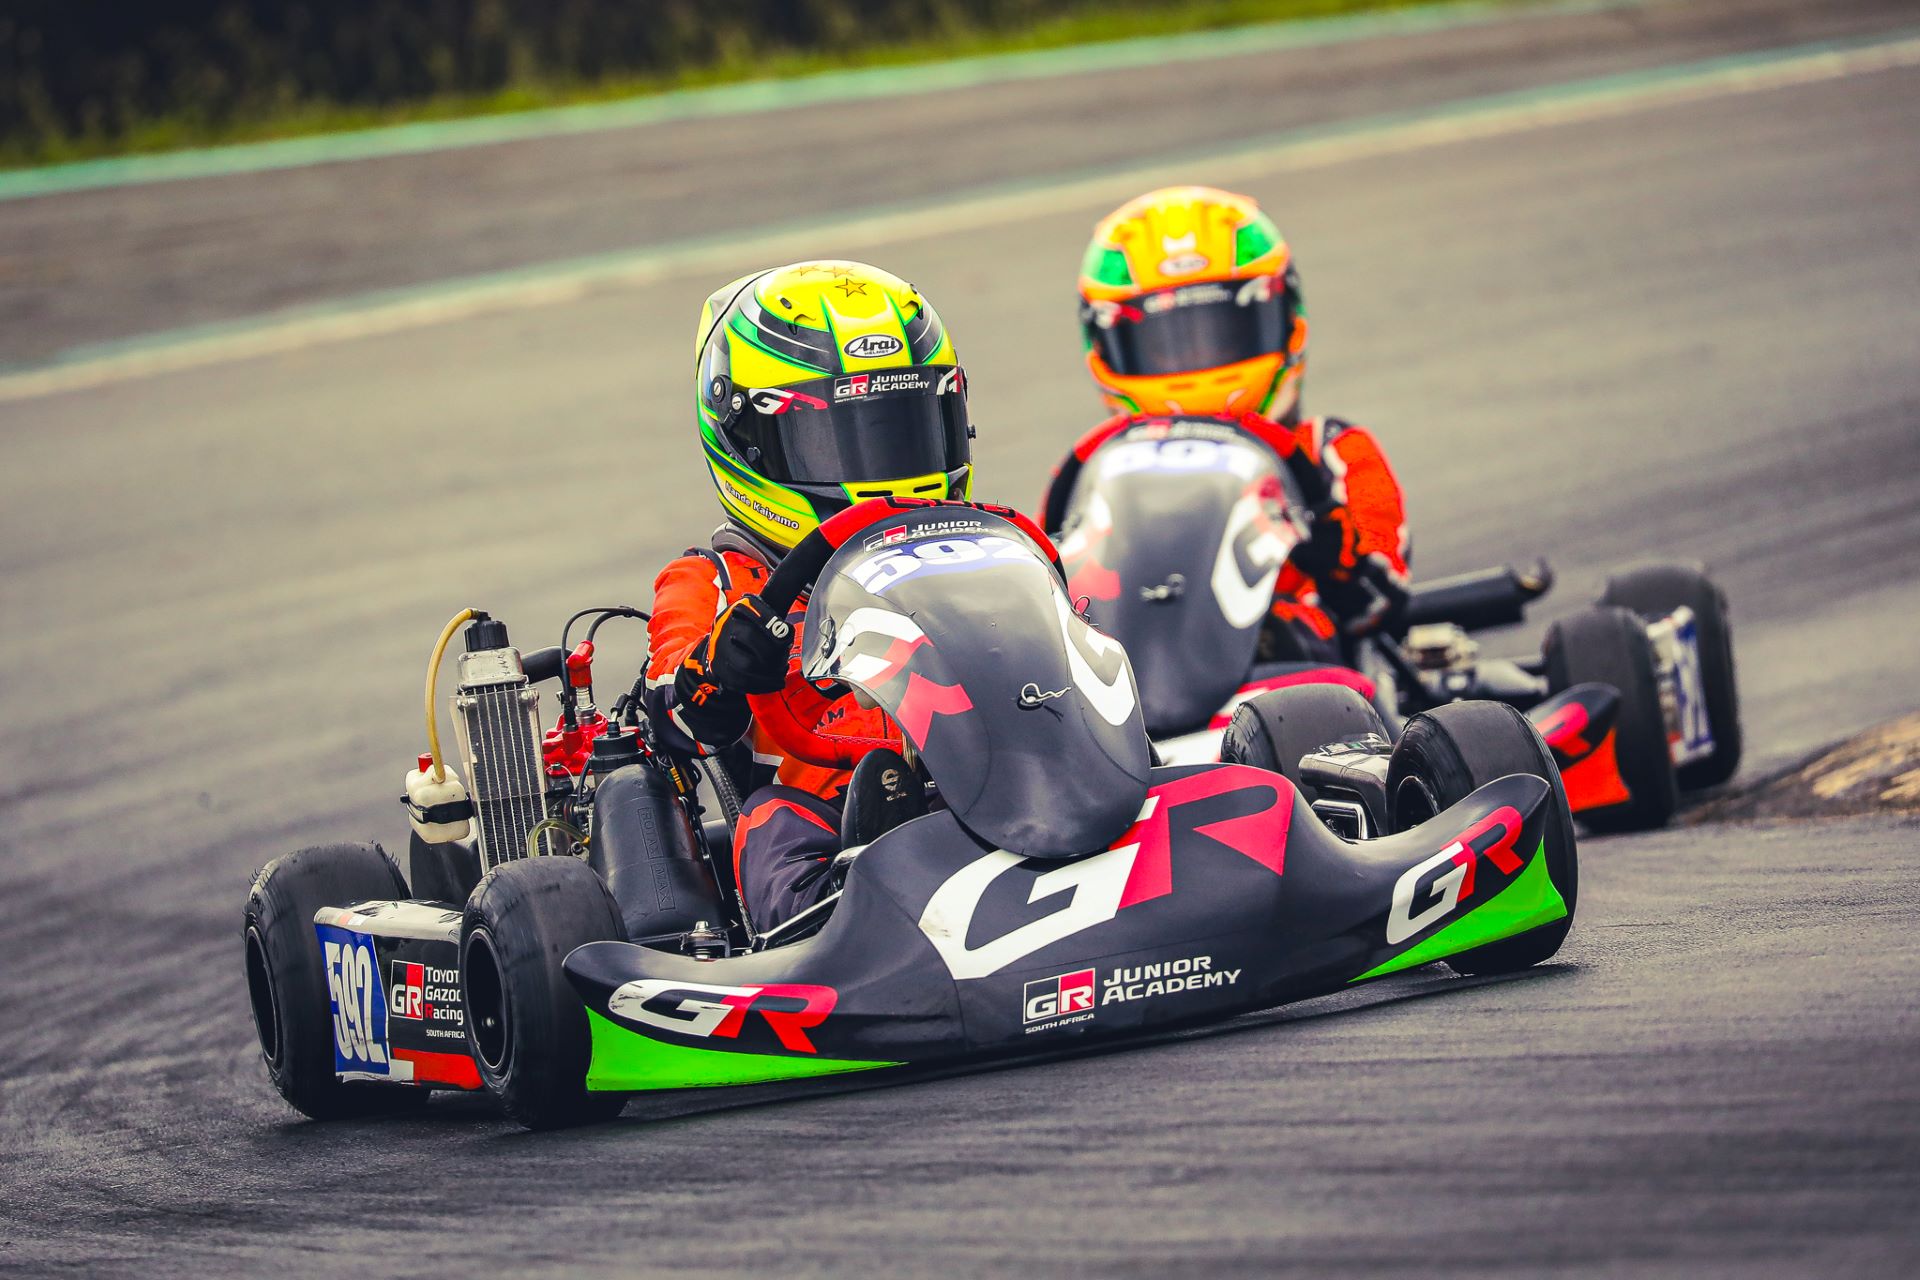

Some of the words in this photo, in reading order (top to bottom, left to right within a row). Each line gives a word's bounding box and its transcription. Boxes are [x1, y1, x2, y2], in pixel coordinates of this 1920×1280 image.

[850, 336, 897, 354] Arai
[835, 382, 868, 397] GR
[870, 381, 930, 393] ACADEMY
[872, 373, 919, 384] JUNIOR
[725, 480, 752, 507] Nande
[752, 500, 800, 530] Kaiyamo
[911, 527, 1000, 539] ACADEMY
[912, 520, 982, 533] JUNIOR
[851, 536, 1046, 594] 592
[920, 766, 1292, 980] GR
[1387, 806, 1523, 944] GR
[425, 966, 459, 983] TOYOT
[1103, 956, 1212, 987] JUNIOR
[391, 983, 422, 1017] GR
[1101, 969, 1242, 1006] ACADEMY
[325, 942, 387, 1063] 592
[425, 1004, 463, 1025] Racing
[1026, 985, 1093, 1019] GR
[608, 979, 838, 1053] GR
[1025, 1021, 1058, 1034] SOUTH
[1059, 1013, 1095, 1026] AFRICA
[426, 1029, 443, 1038] SOUTH
[444, 1030, 465, 1039] AFRICA
